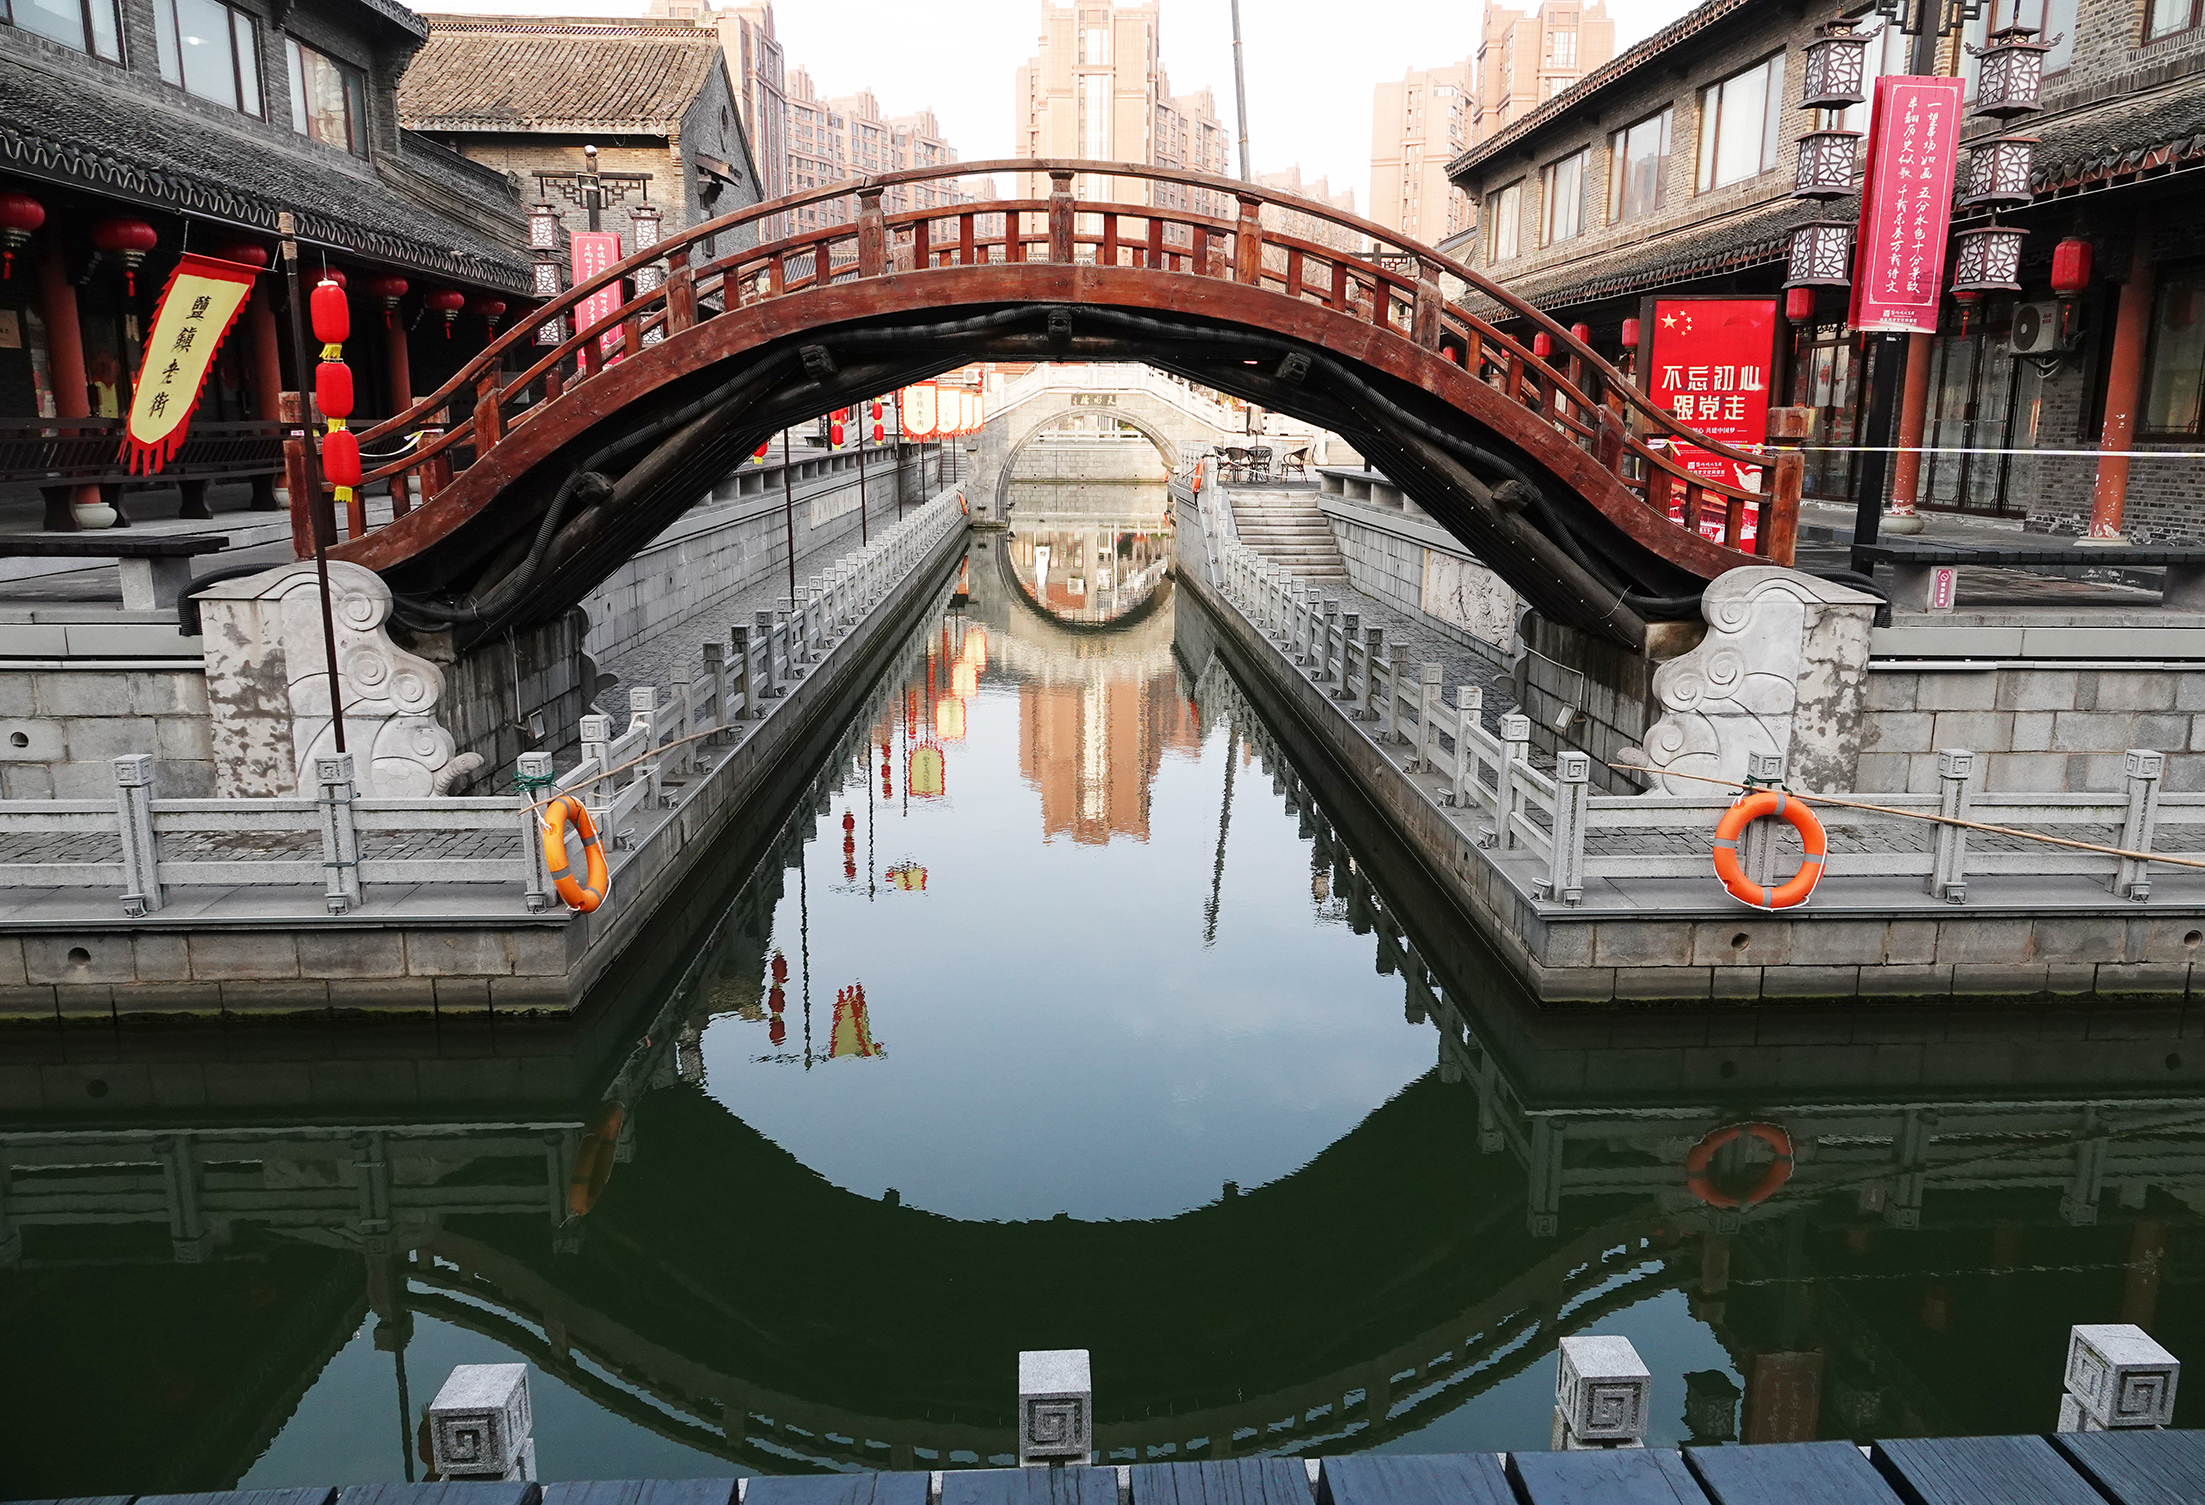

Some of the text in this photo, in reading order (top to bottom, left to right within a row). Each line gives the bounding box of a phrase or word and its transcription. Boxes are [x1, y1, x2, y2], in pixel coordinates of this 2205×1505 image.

[1906, 186, 1931, 294] 五分水色十分景致
[1661, 365, 1761, 391] 不忘初心
[1673, 395, 1746, 420] 跟党走
